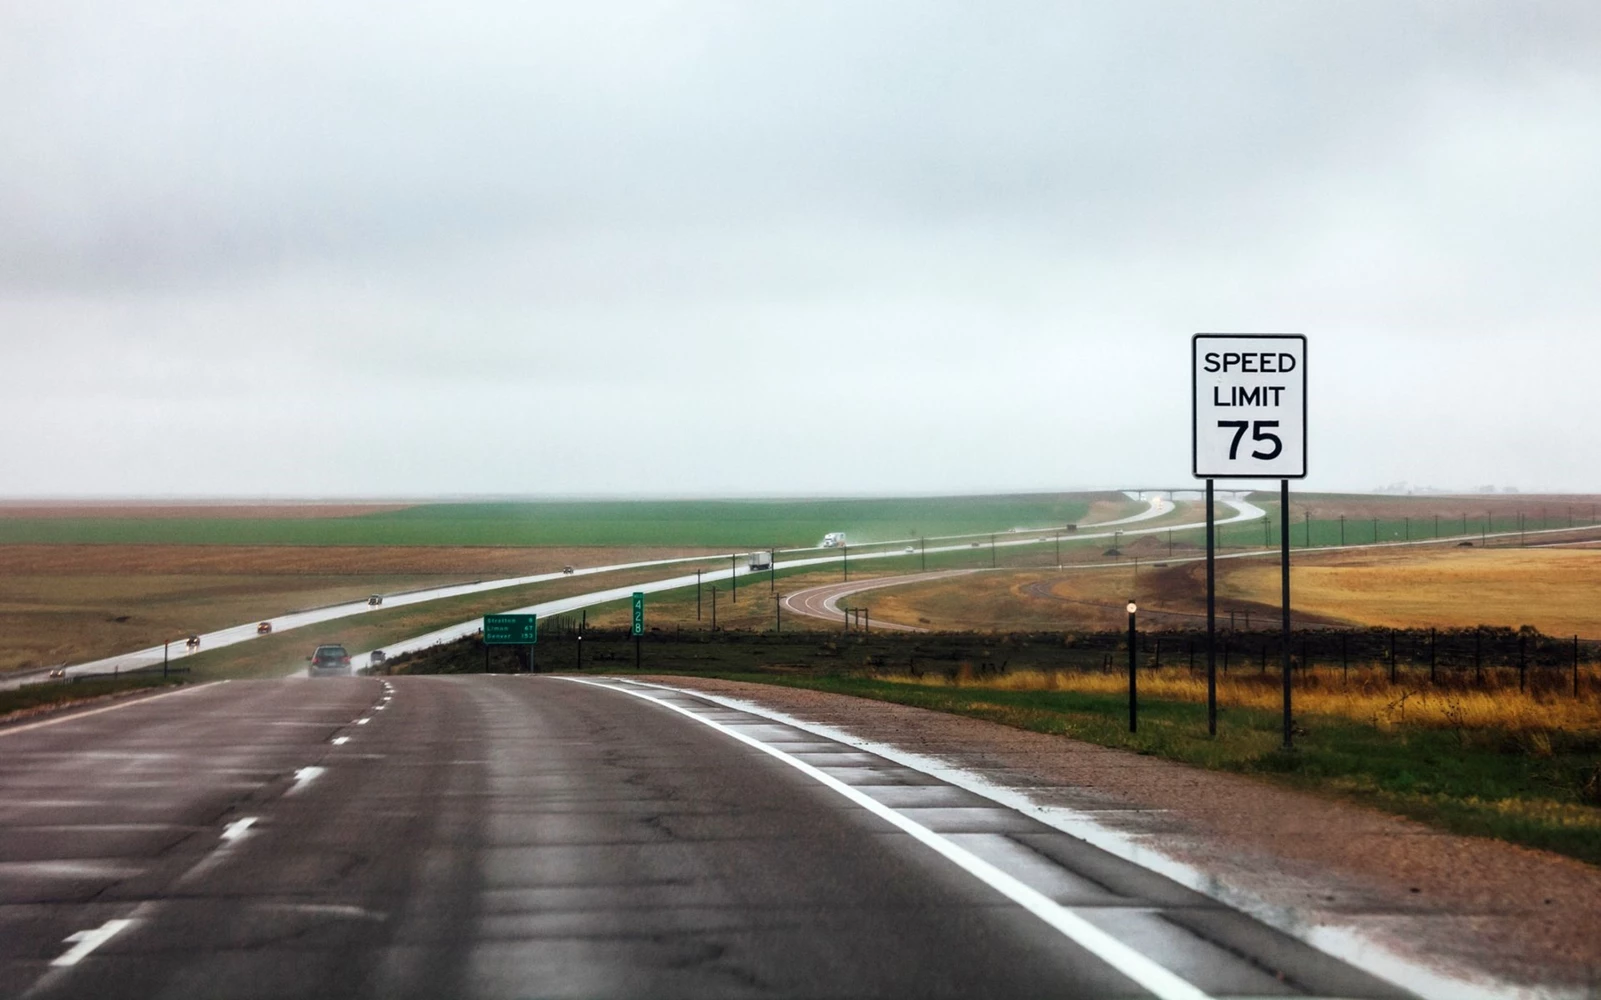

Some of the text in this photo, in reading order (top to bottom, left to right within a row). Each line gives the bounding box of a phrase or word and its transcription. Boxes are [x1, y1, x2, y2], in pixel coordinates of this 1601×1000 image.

[1203, 352, 1296, 373] SPEED
[1213, 386, 1286, 407] LIMIT
[1217, 420, 1283, 461] 75
